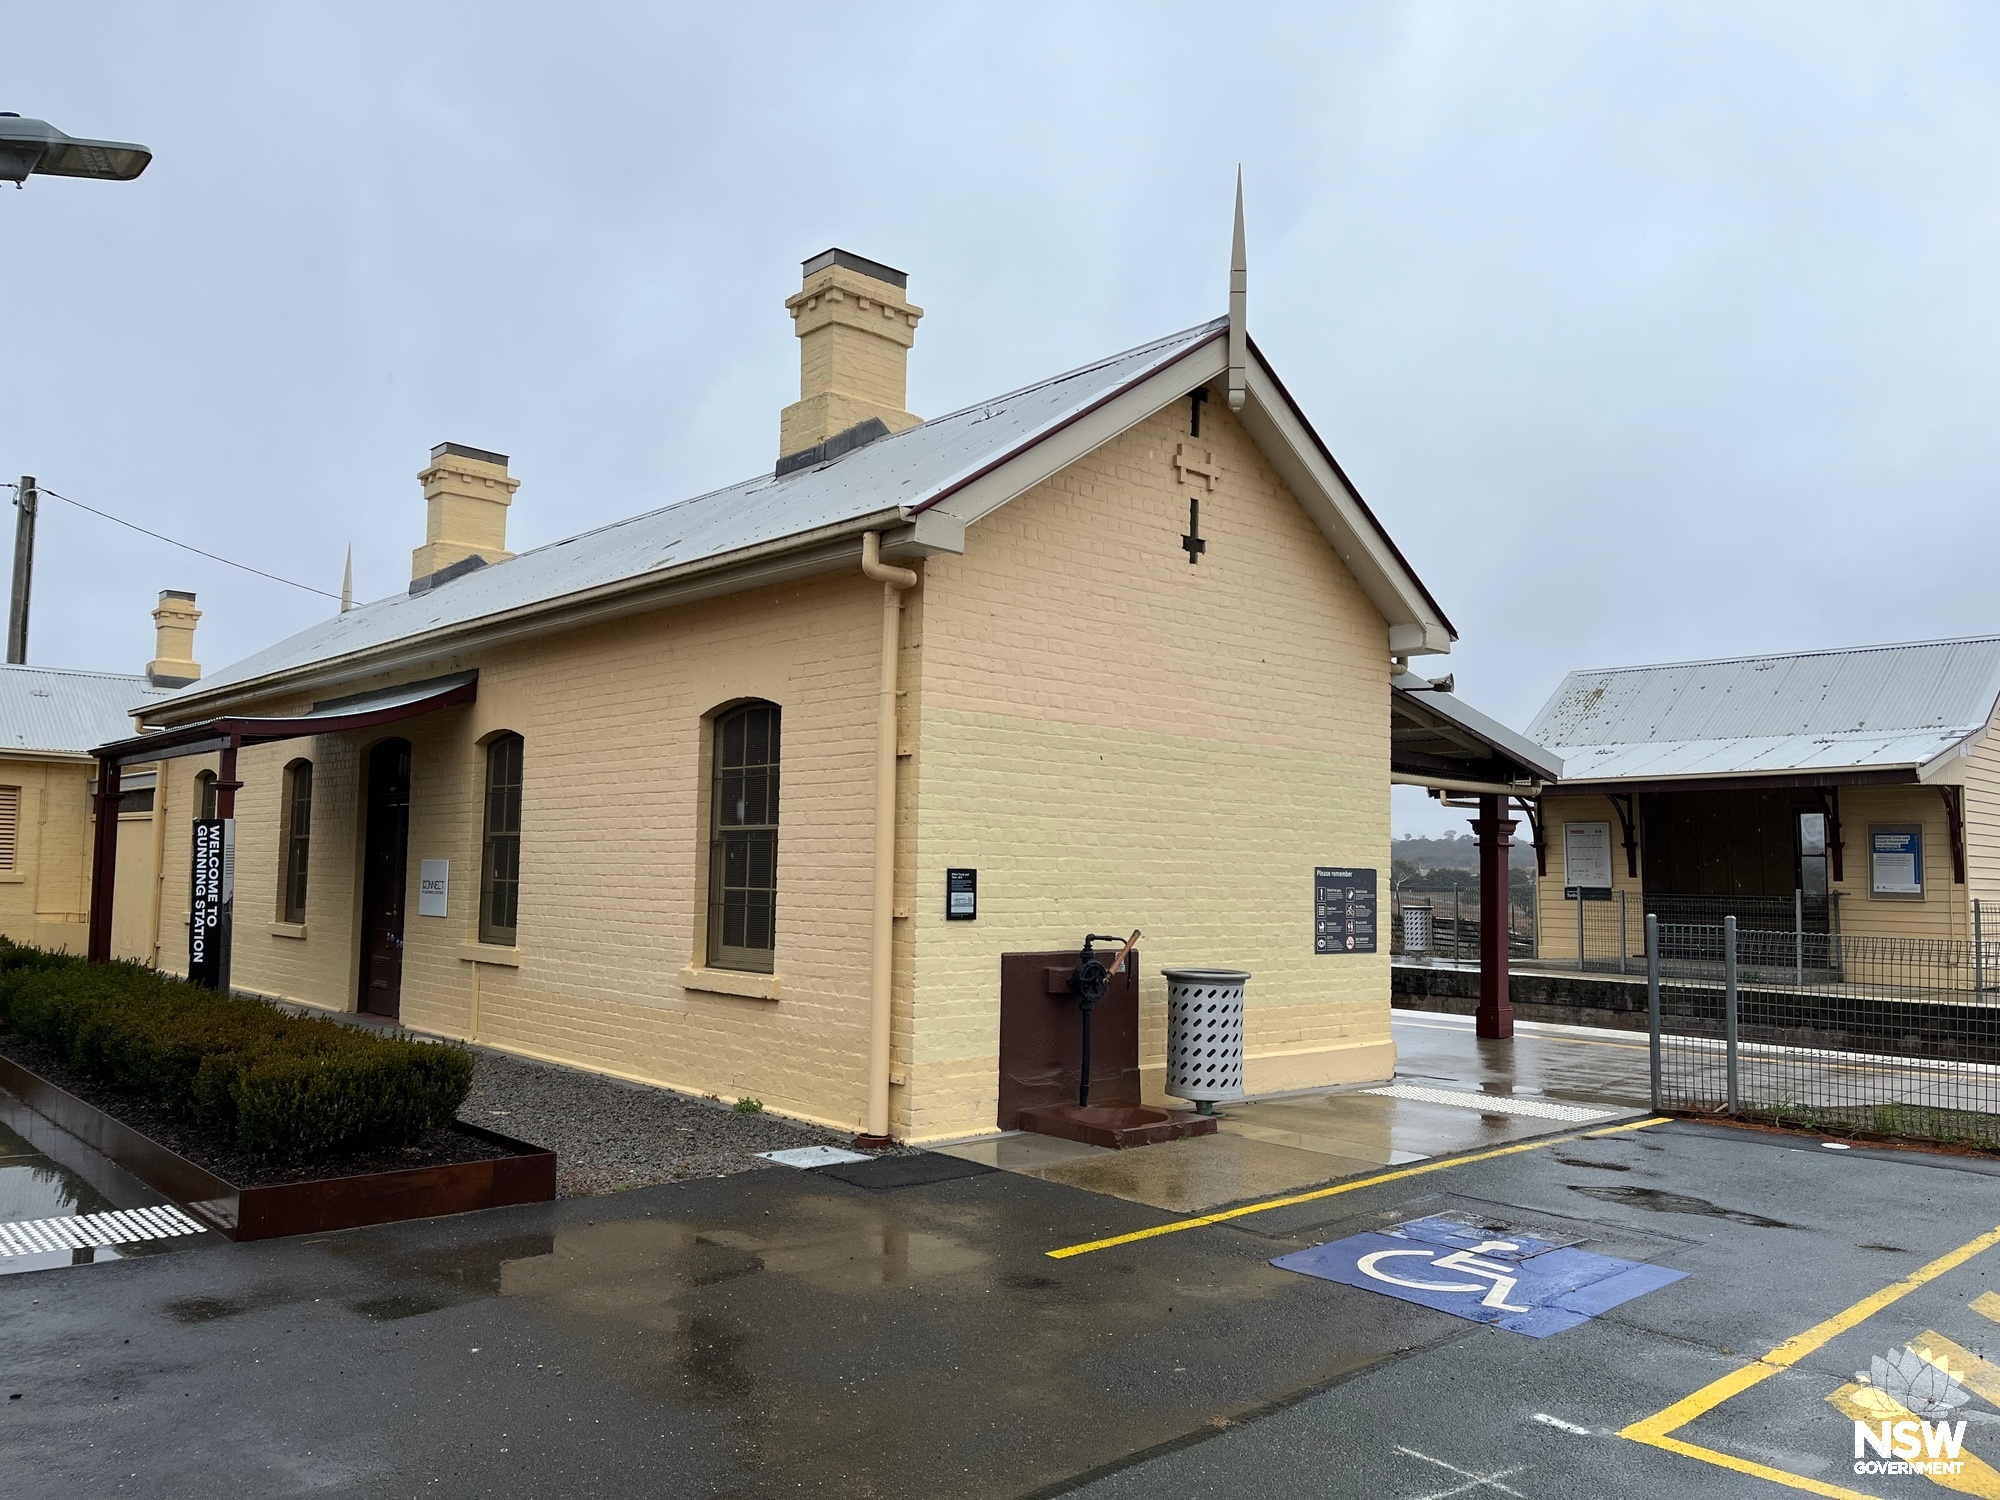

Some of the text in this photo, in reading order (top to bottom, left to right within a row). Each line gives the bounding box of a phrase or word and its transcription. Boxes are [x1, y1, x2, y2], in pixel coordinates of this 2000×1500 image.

[193, 825, 208, 963] GUNNING STATION
[207, 825, 220, 928] WELCOME TO
[422, 880, 444, 890] CONNECT
